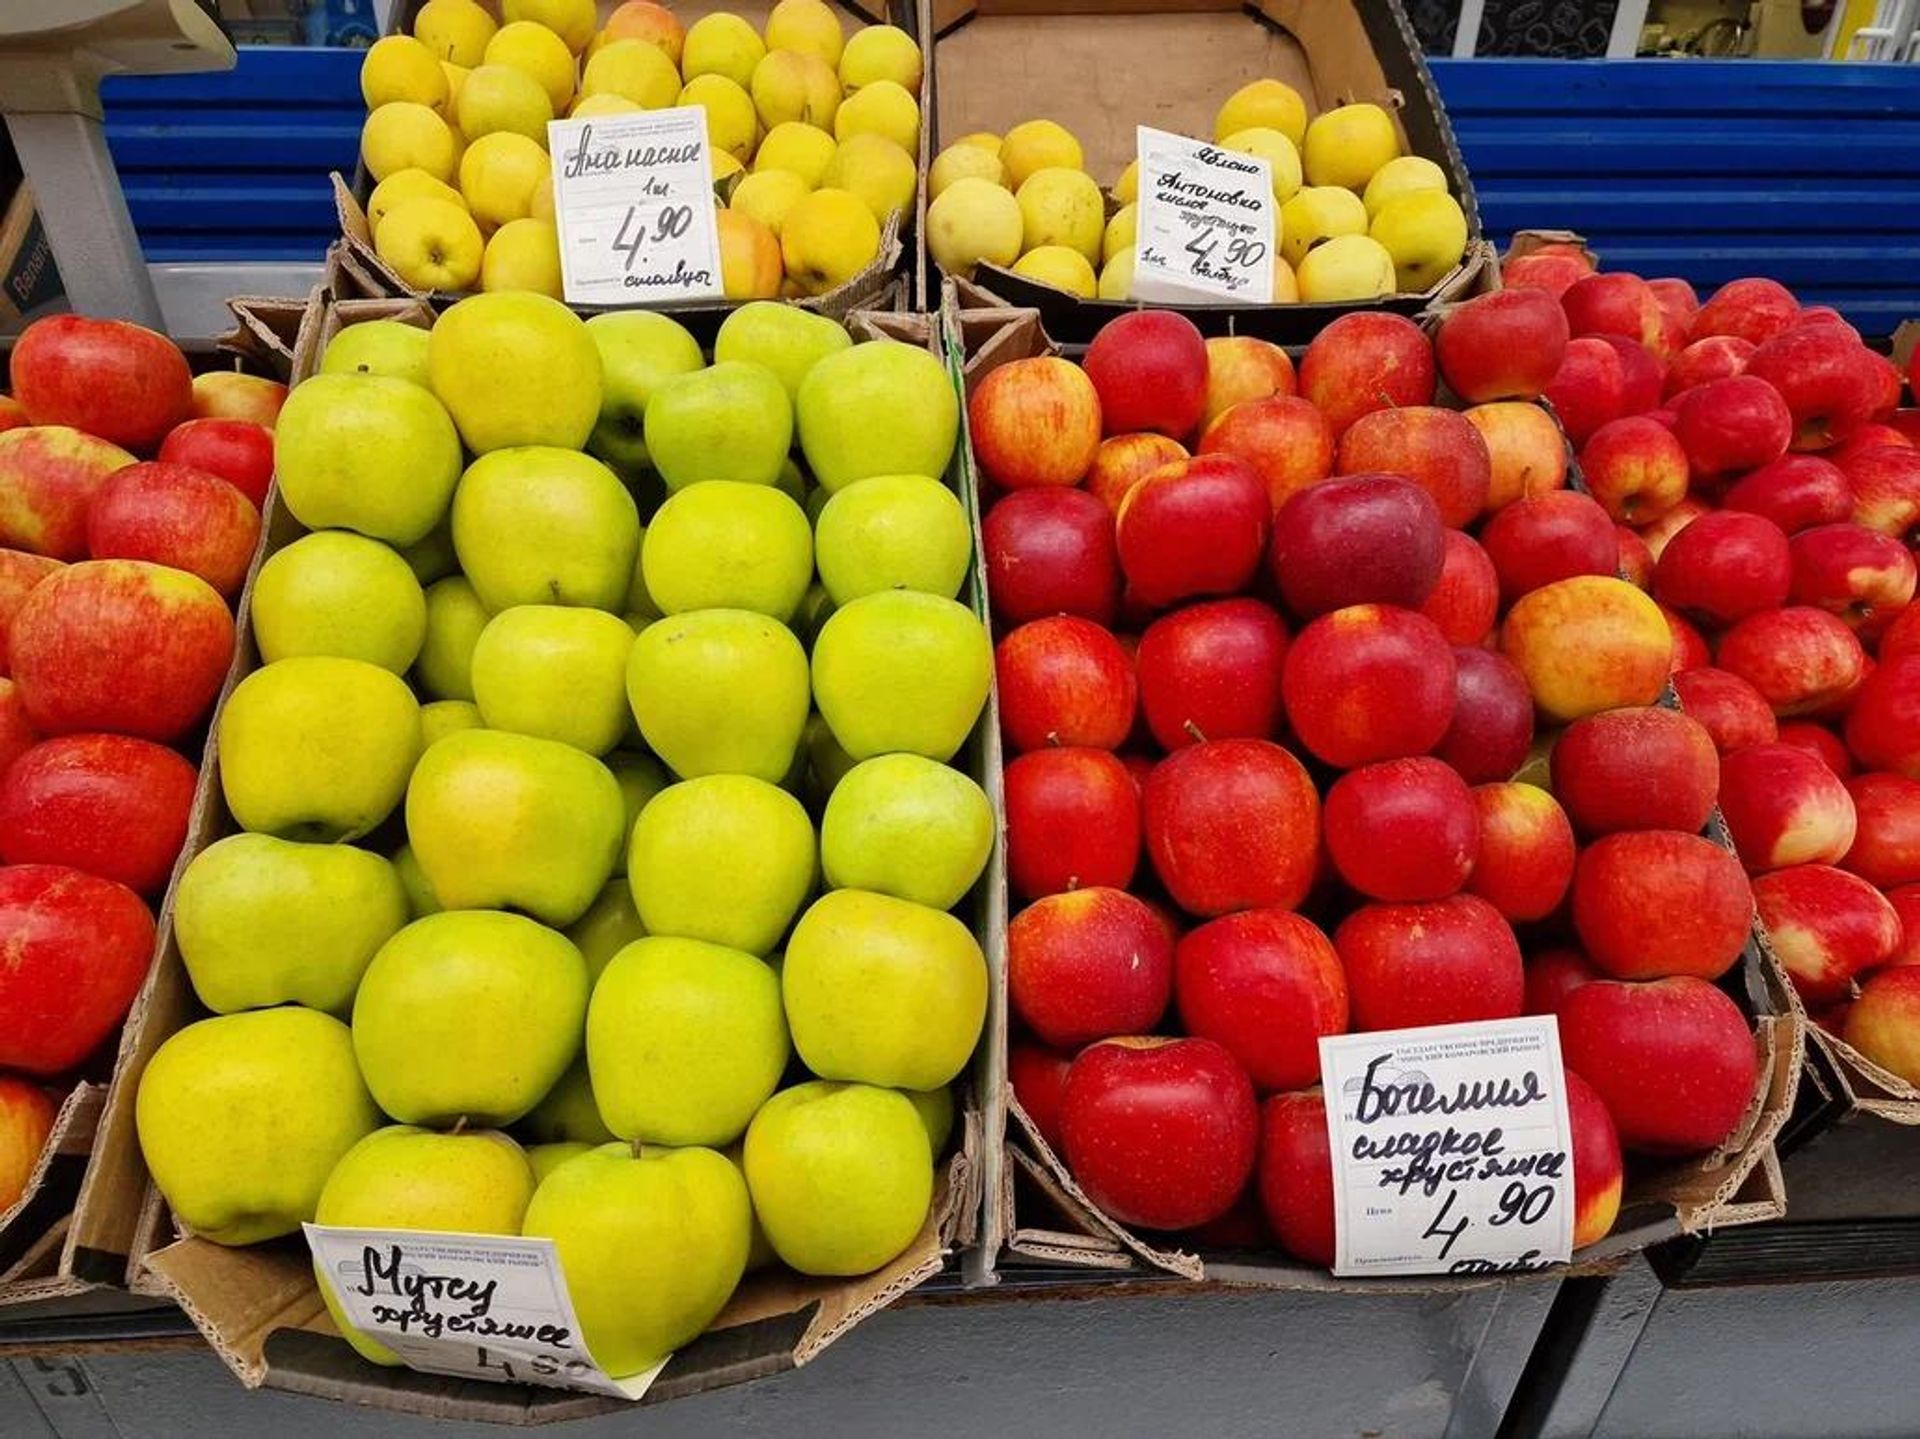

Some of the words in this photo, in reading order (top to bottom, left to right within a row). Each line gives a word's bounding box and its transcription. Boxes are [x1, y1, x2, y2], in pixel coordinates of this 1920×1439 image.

[1157, 172, 1262, 211] Антоновка
[1355, 1053, 1546, 1124] Богемия
[1352, 1127, 1504, 1159] сладкое
[358, 1245, 497, 1317] Мутсу
